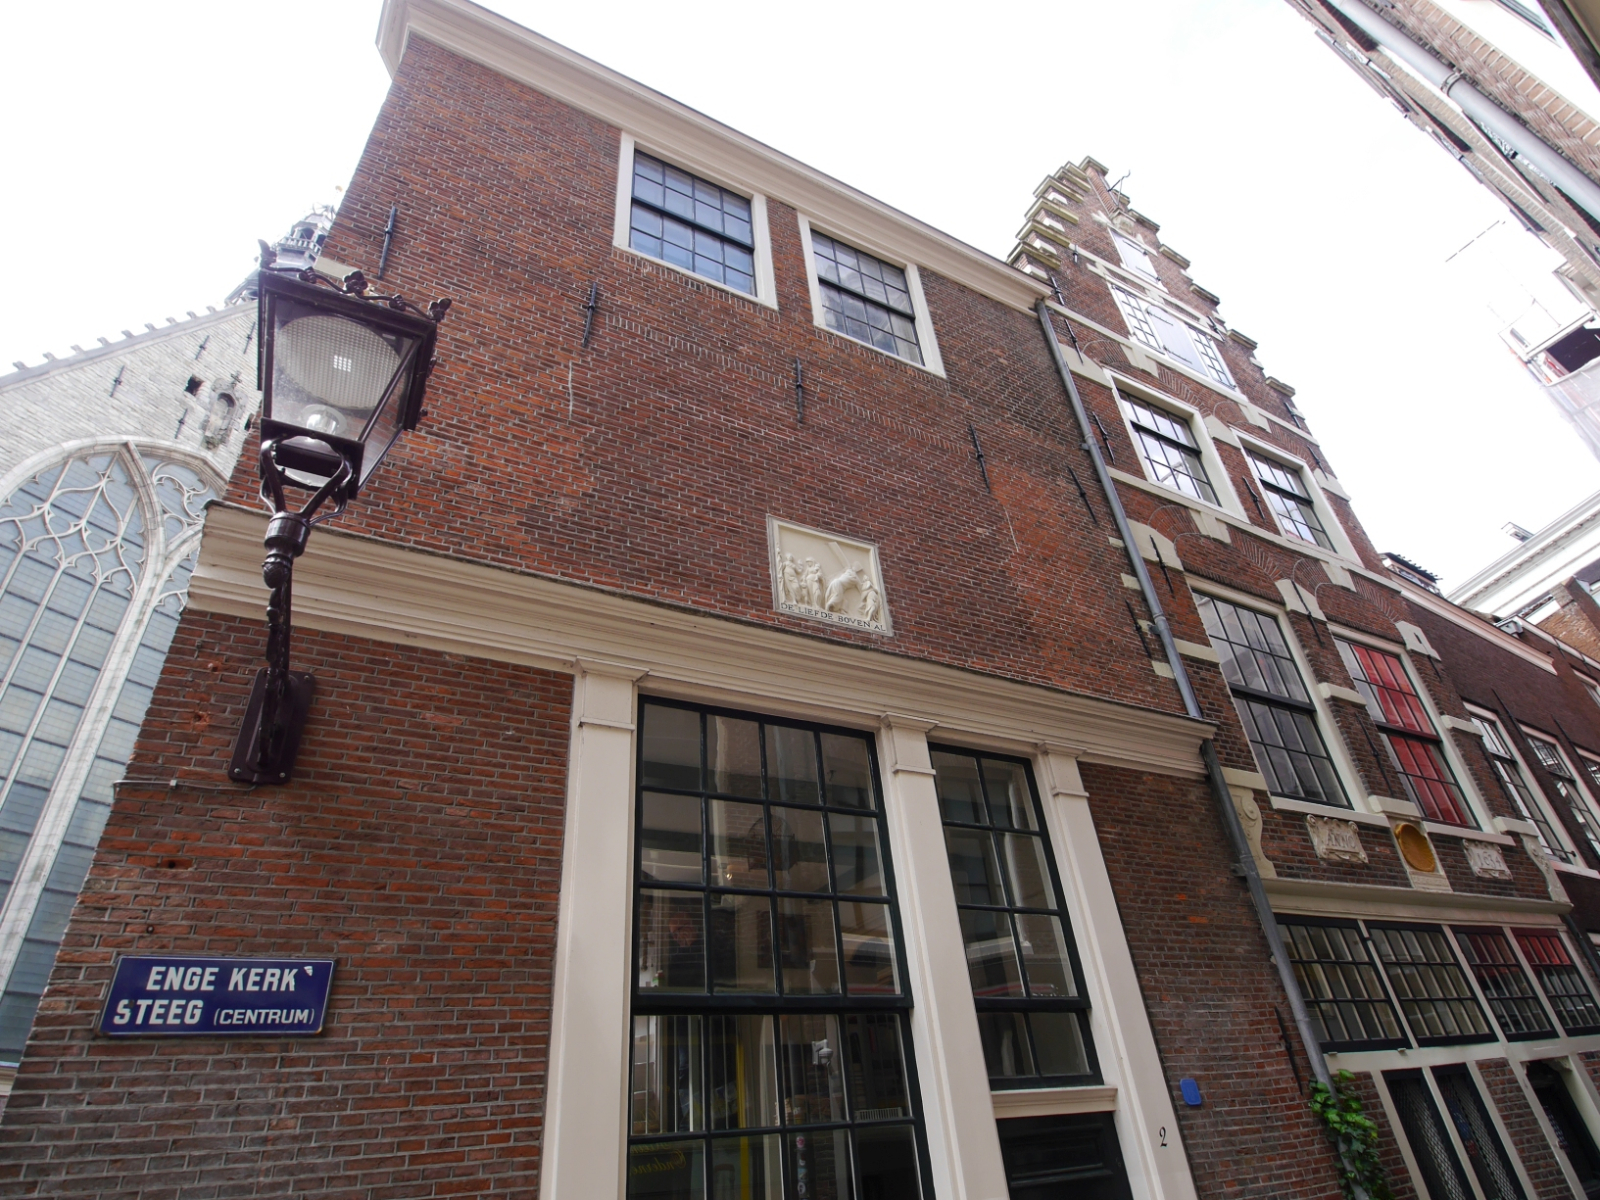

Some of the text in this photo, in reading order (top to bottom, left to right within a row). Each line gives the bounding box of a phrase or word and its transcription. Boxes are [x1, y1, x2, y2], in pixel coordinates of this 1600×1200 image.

[780, 602, 795, 612] DE
[837, 615, 871, 628] BOVEN
[874, 624, 886, 632] AL
[146, 966, 298, 991] ENGE KERK
[113, 999, 315, 1026] STEEG (CENTRUM)
[1158, 1126, 1168, 1148] 2
